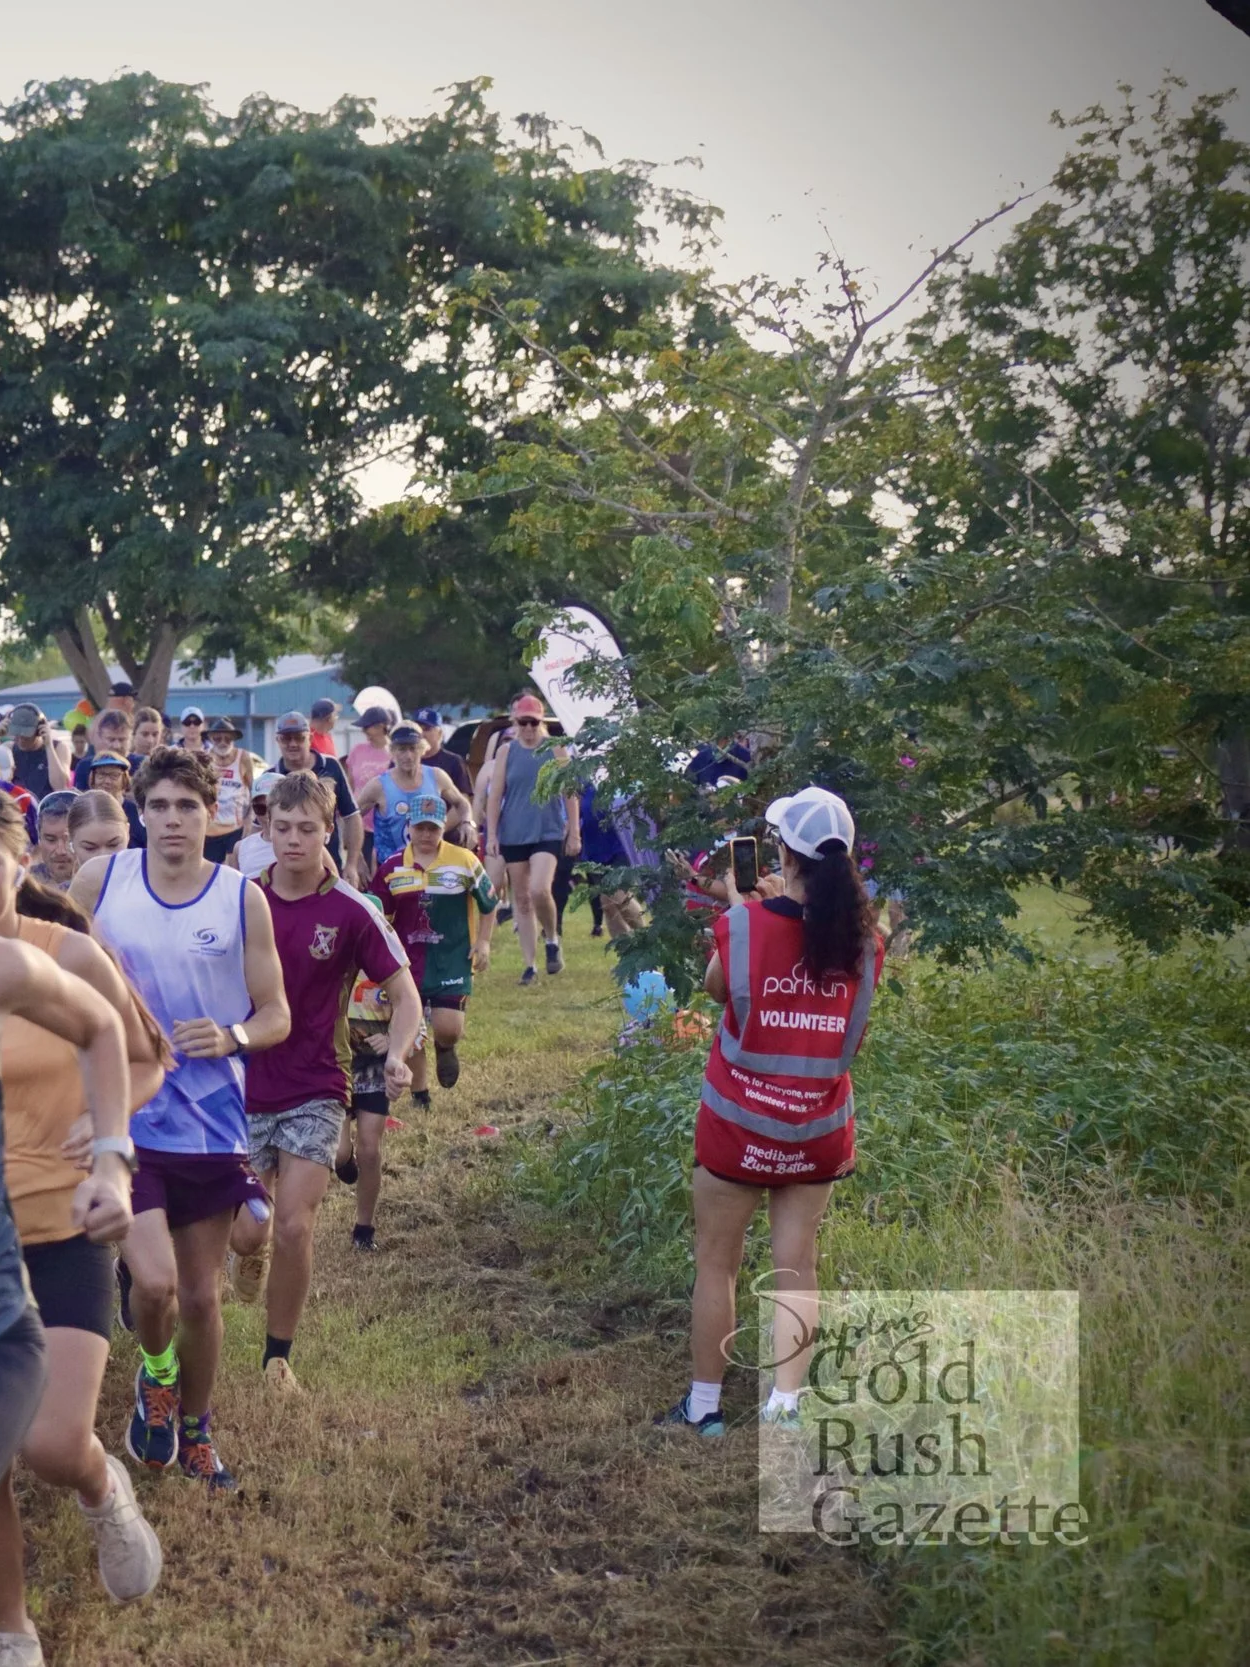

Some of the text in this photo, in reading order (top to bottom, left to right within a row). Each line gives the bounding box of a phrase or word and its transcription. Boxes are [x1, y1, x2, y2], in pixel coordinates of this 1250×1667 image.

[759, 1010, 846, 1034] VOLUNTEER
[731, 1069, 751, 1085] Free,
[752, 1078, 763, 1088] for
[765, 1083, 804, 1100] everyone,
[745, 1088, 787, 1110] Volunteer,
[741, 1154, 817, 1174] Live Better
[746, 1144, 806, 1162] medibank
